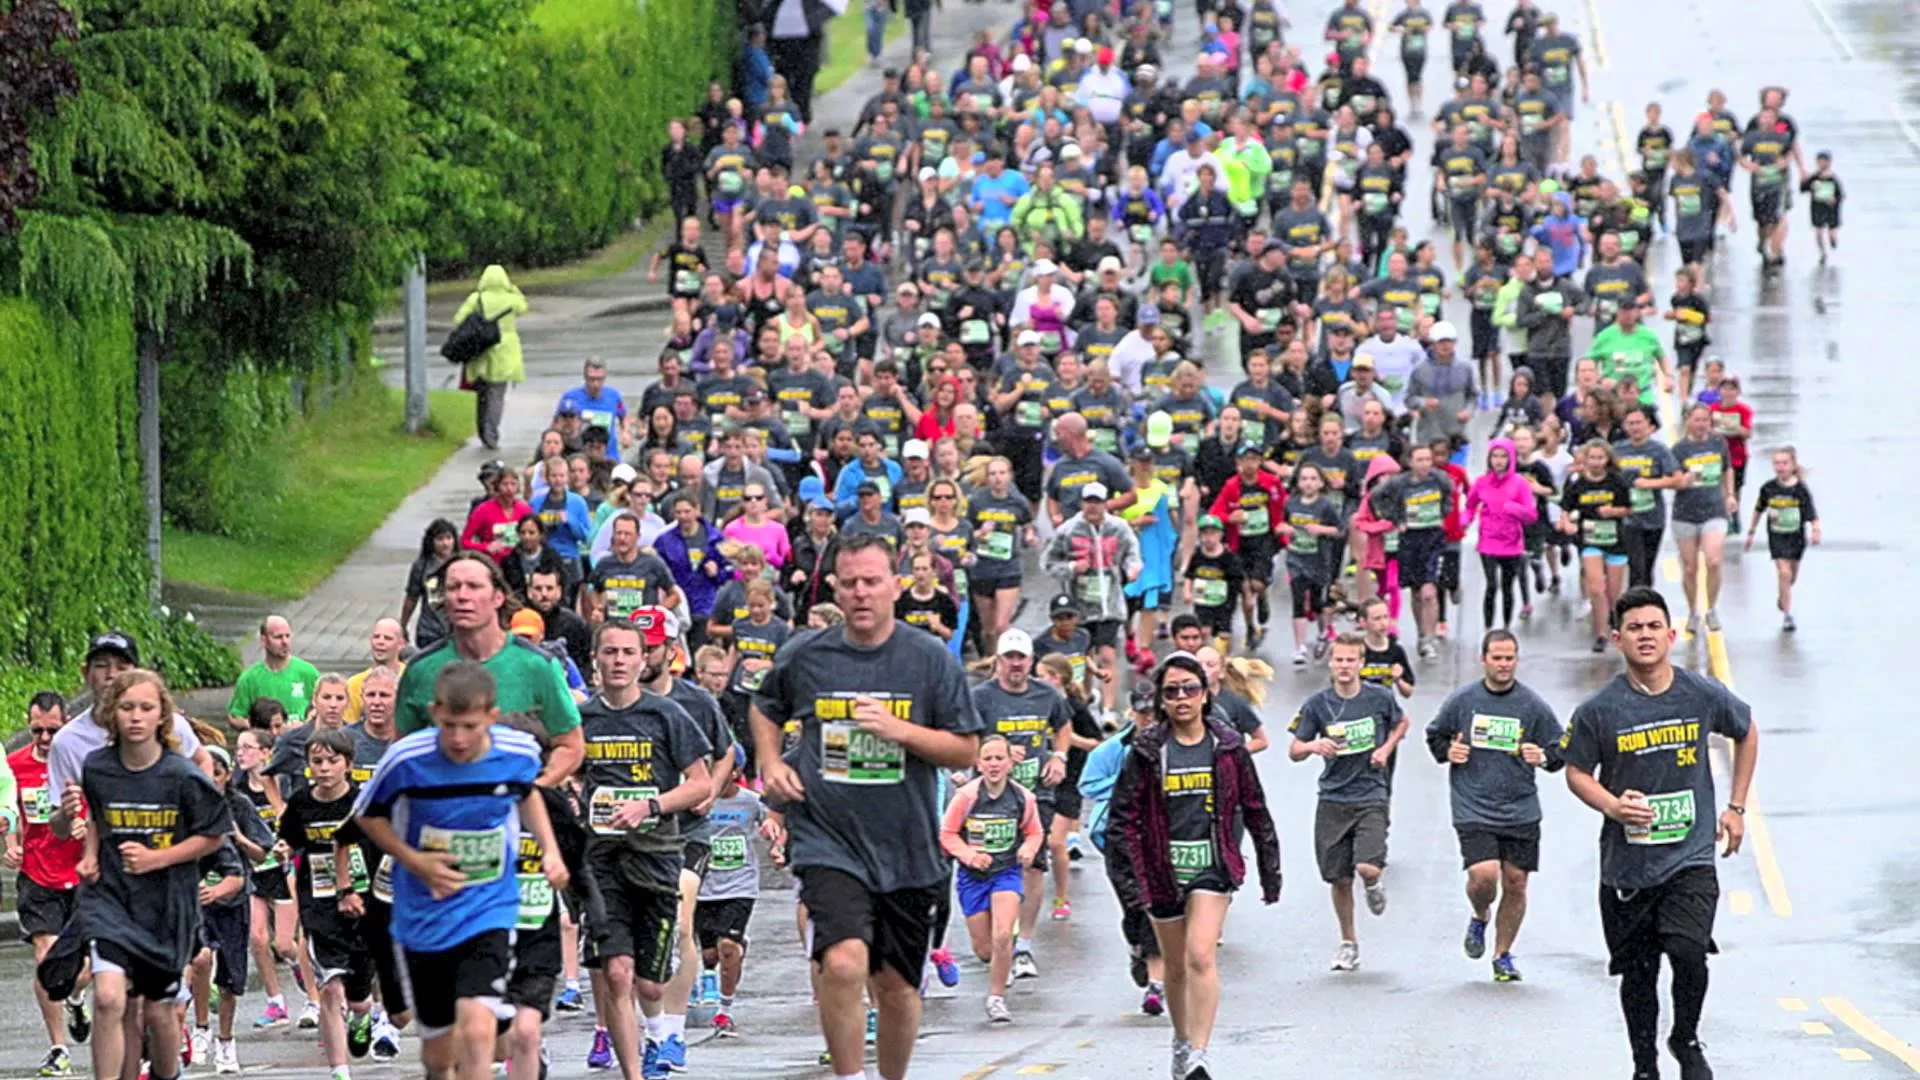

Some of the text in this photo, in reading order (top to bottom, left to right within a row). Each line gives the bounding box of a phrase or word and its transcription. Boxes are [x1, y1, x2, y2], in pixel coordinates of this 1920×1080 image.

[1616, 731, 1648, 753] RUN
[1649, 726, 1685, 747] WITH
[1686, 723, 1700, 742] IT
[1676, 747, 1697, 767] 5K
[1652, 799, 1692, 824] 3734
[1171, 846, 1207, 867] 3731
